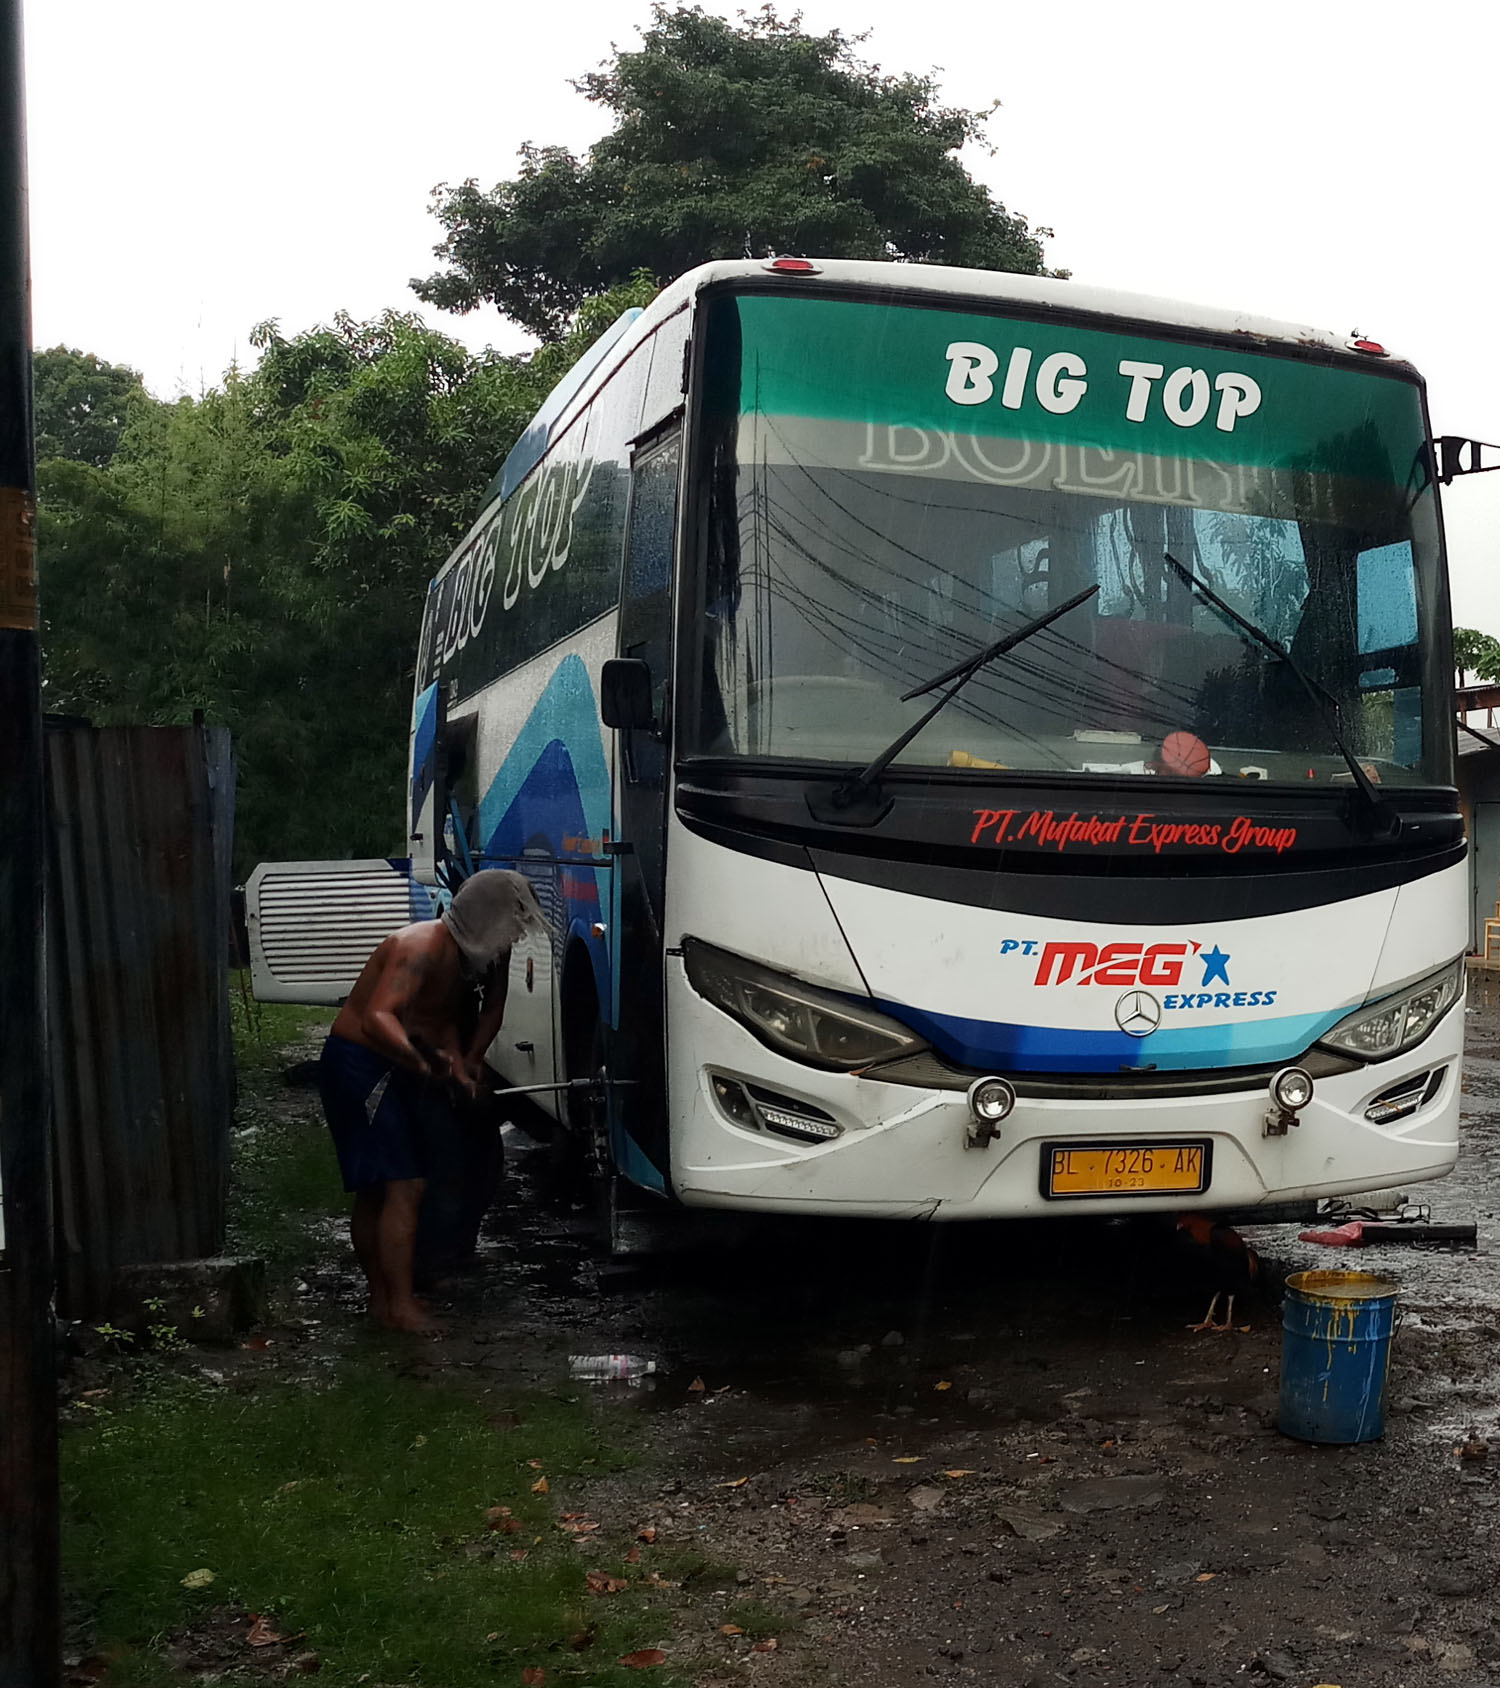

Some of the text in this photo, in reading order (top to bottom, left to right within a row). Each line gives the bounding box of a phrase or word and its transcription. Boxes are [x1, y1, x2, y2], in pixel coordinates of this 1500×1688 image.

[944, 341, 1263, 434] BIG TOP
[971, 810, 1013, 843] PT.
[1129, 814, 1220, 853] Express
[1221, 816, 1297, 855] Group
[1000, 939, 1039, 956] PT.
[1163, 991, 1278, 1010] EXPRESS
[1053, 1149, 1198, 1175] BL 7326 AK
